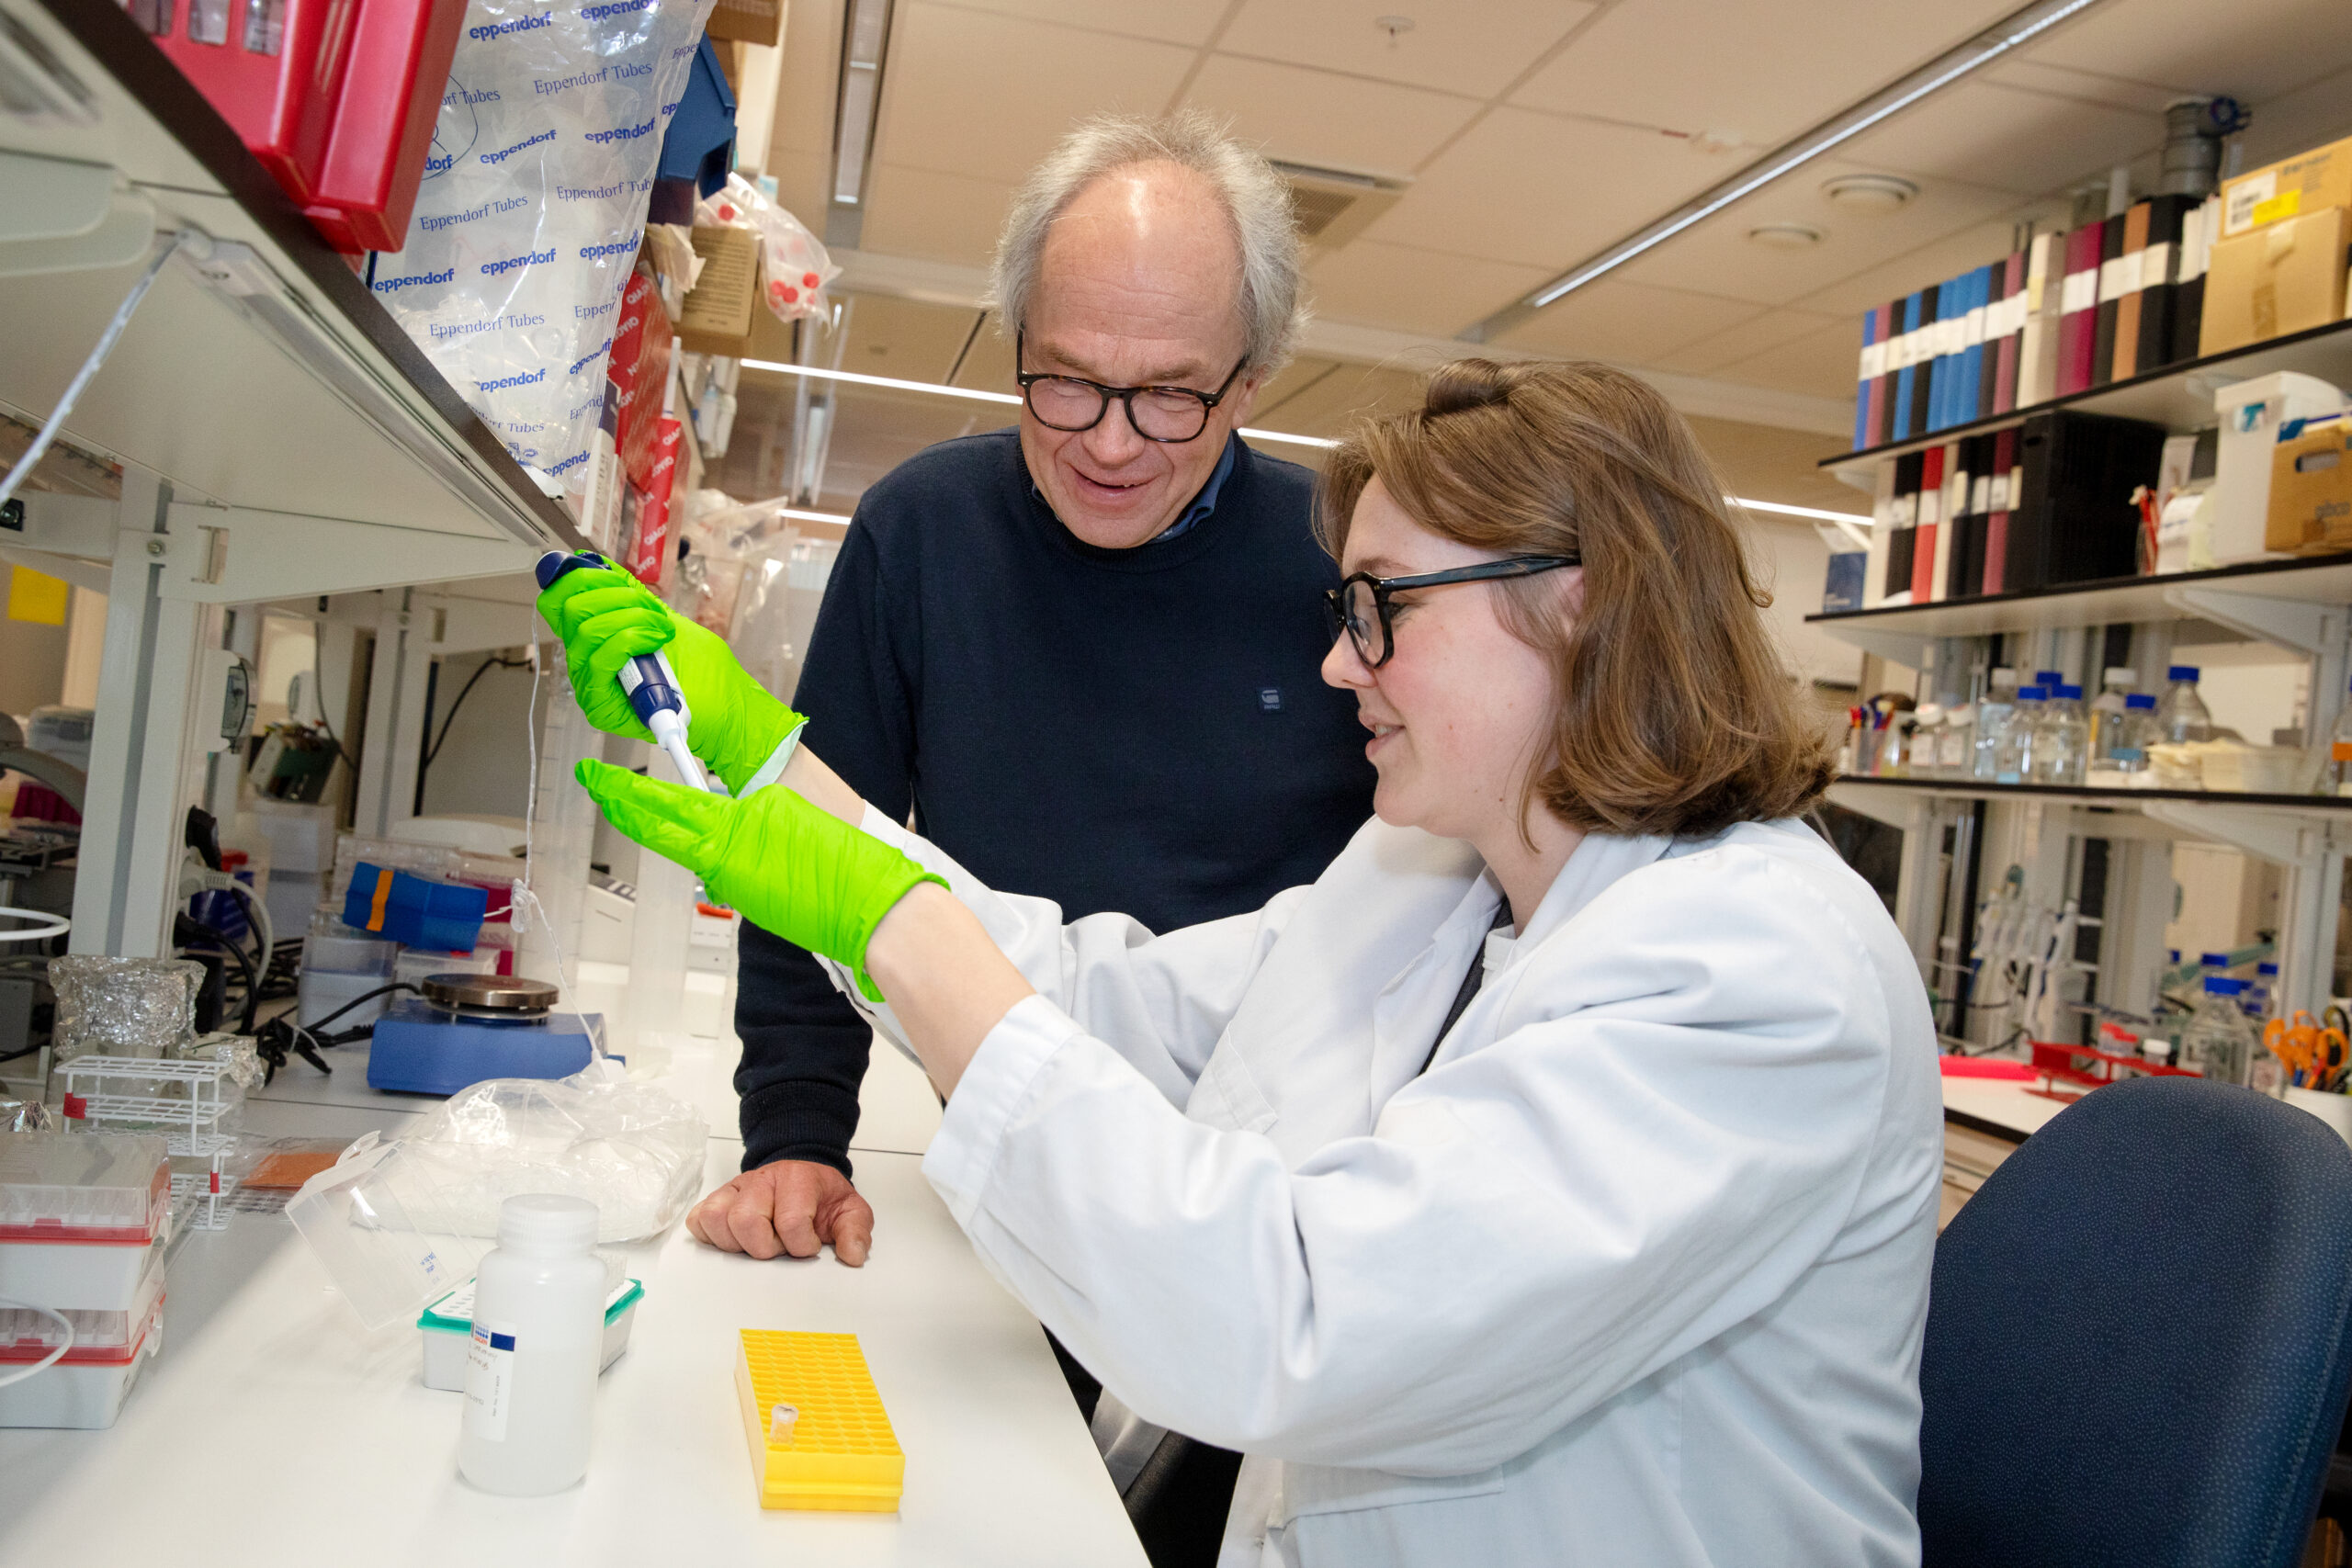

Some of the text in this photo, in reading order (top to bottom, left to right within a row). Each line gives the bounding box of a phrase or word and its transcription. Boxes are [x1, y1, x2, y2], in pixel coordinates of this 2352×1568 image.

[469, 11, 552, 42] eppendorf
[534, 62, 653, 96] Eppendorf Tubes
[459, 89, 501, 105] Tubes
[585, 118, 656, 144] eppendorf
[480, 130, 558, 165] eppendorf
[557, 178, 652, 201] Eppendorf Tub
[420, 195, 528, 231] Eppendorf Tubes
[481, 248, 557, 276] eppendorf
[374, 268, 455, 293] eppendorf
[430, 313, 545, 339] Eppendorf Tubes
[474, 368, 546, 392] ppendorf
[506, 422, 545, 433] Tubes
